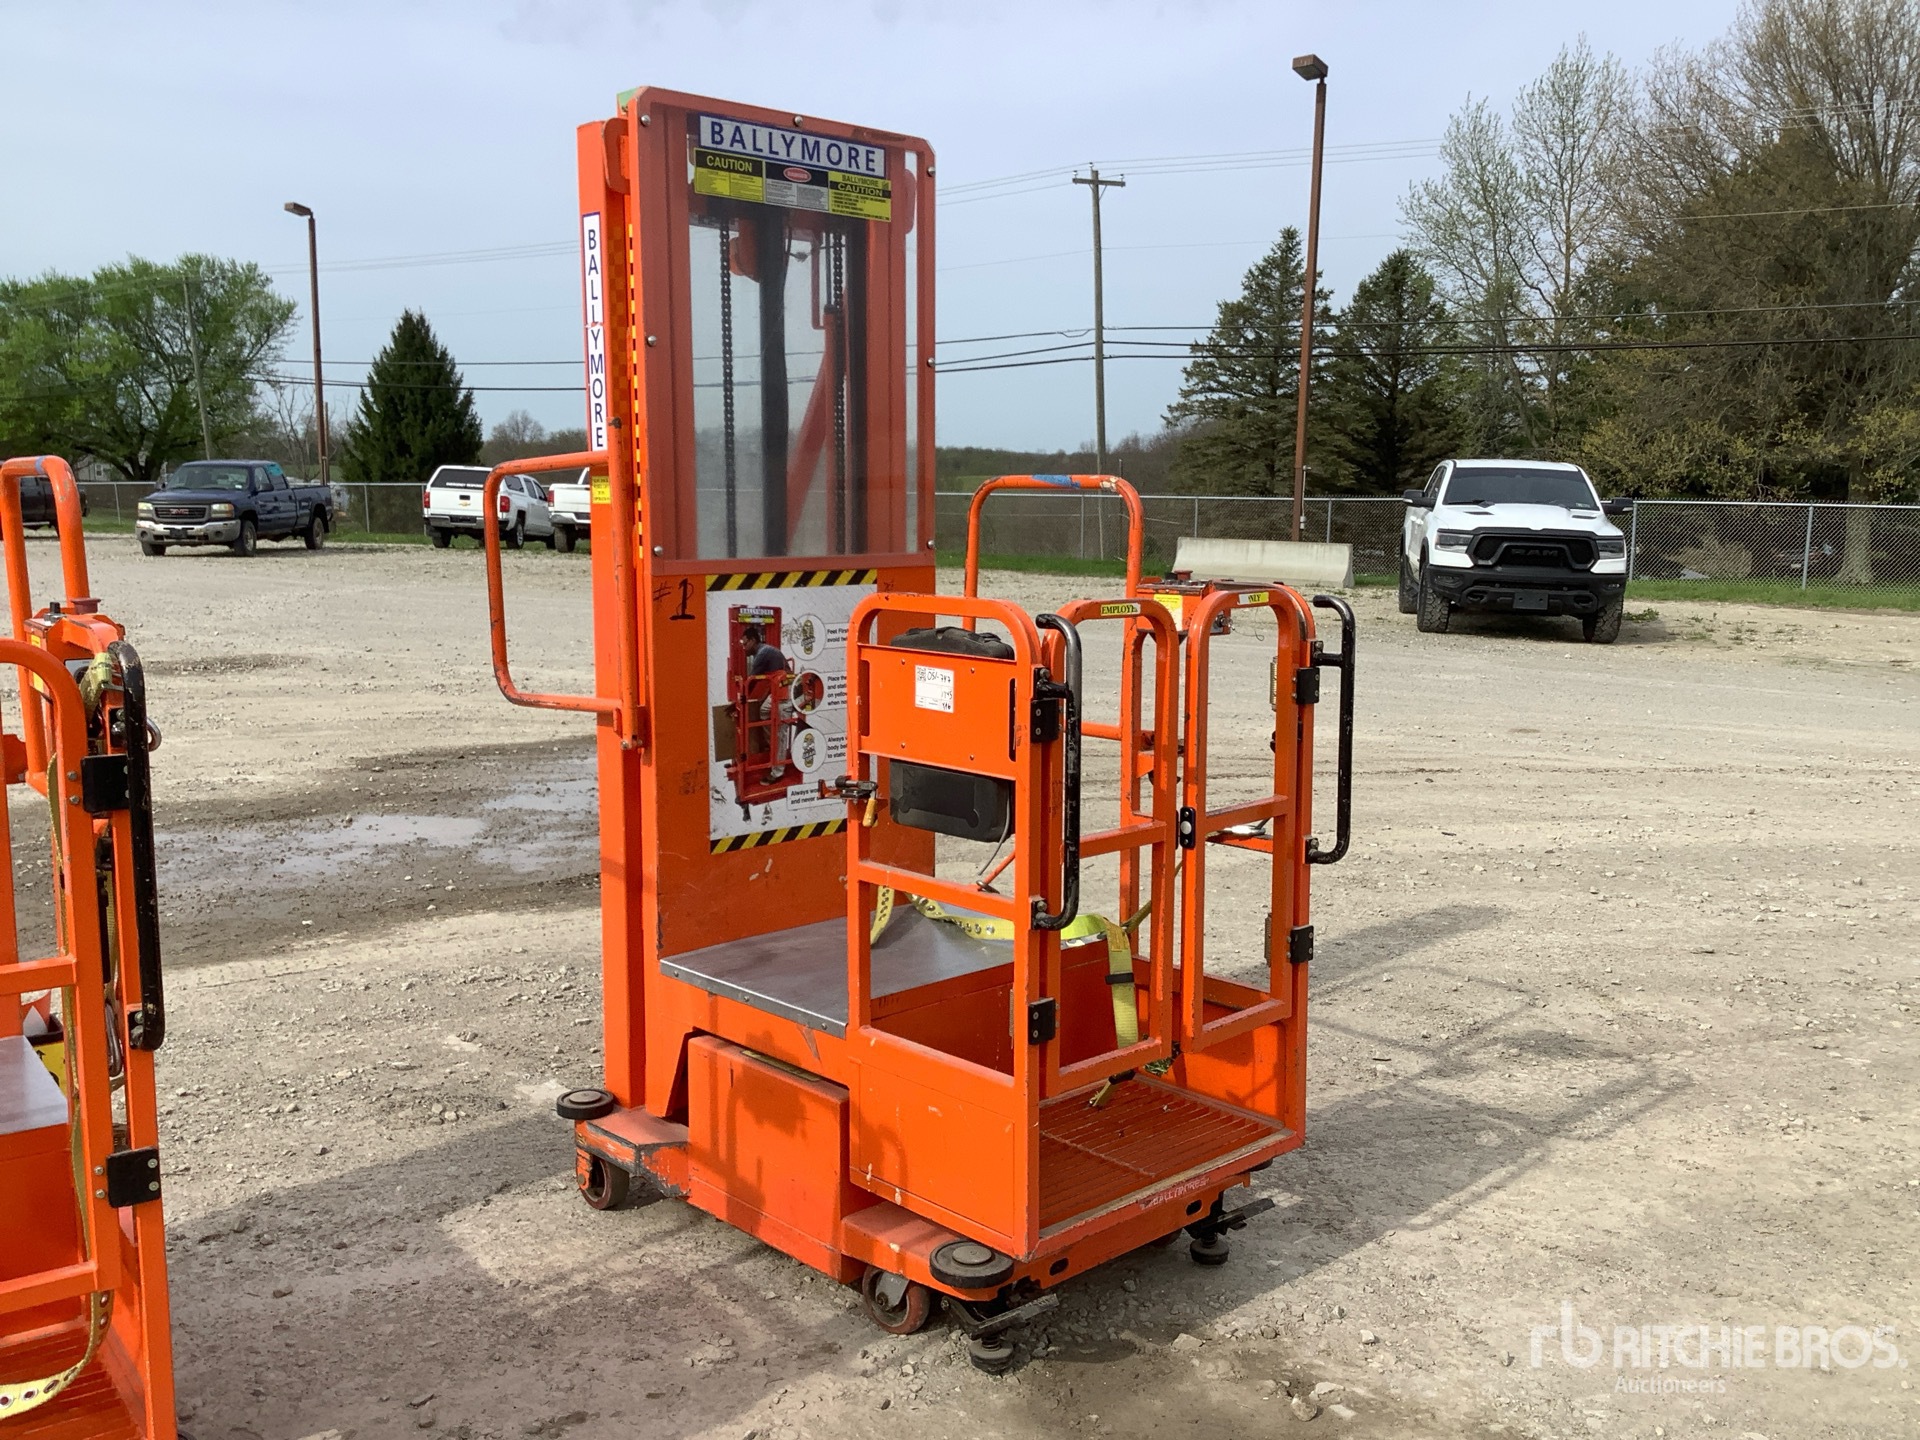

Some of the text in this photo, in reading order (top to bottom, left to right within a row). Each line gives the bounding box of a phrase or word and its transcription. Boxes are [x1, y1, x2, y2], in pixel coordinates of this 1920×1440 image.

[710, 121, 876, 173] BALLYMORE
[706, 155, 753, 173] CAUTION
[841, 174, 879, 187] BALLYMORE
[837, 183, 883, 197] CAUTION
[587, 229, 604, 448] BALLYMORE
